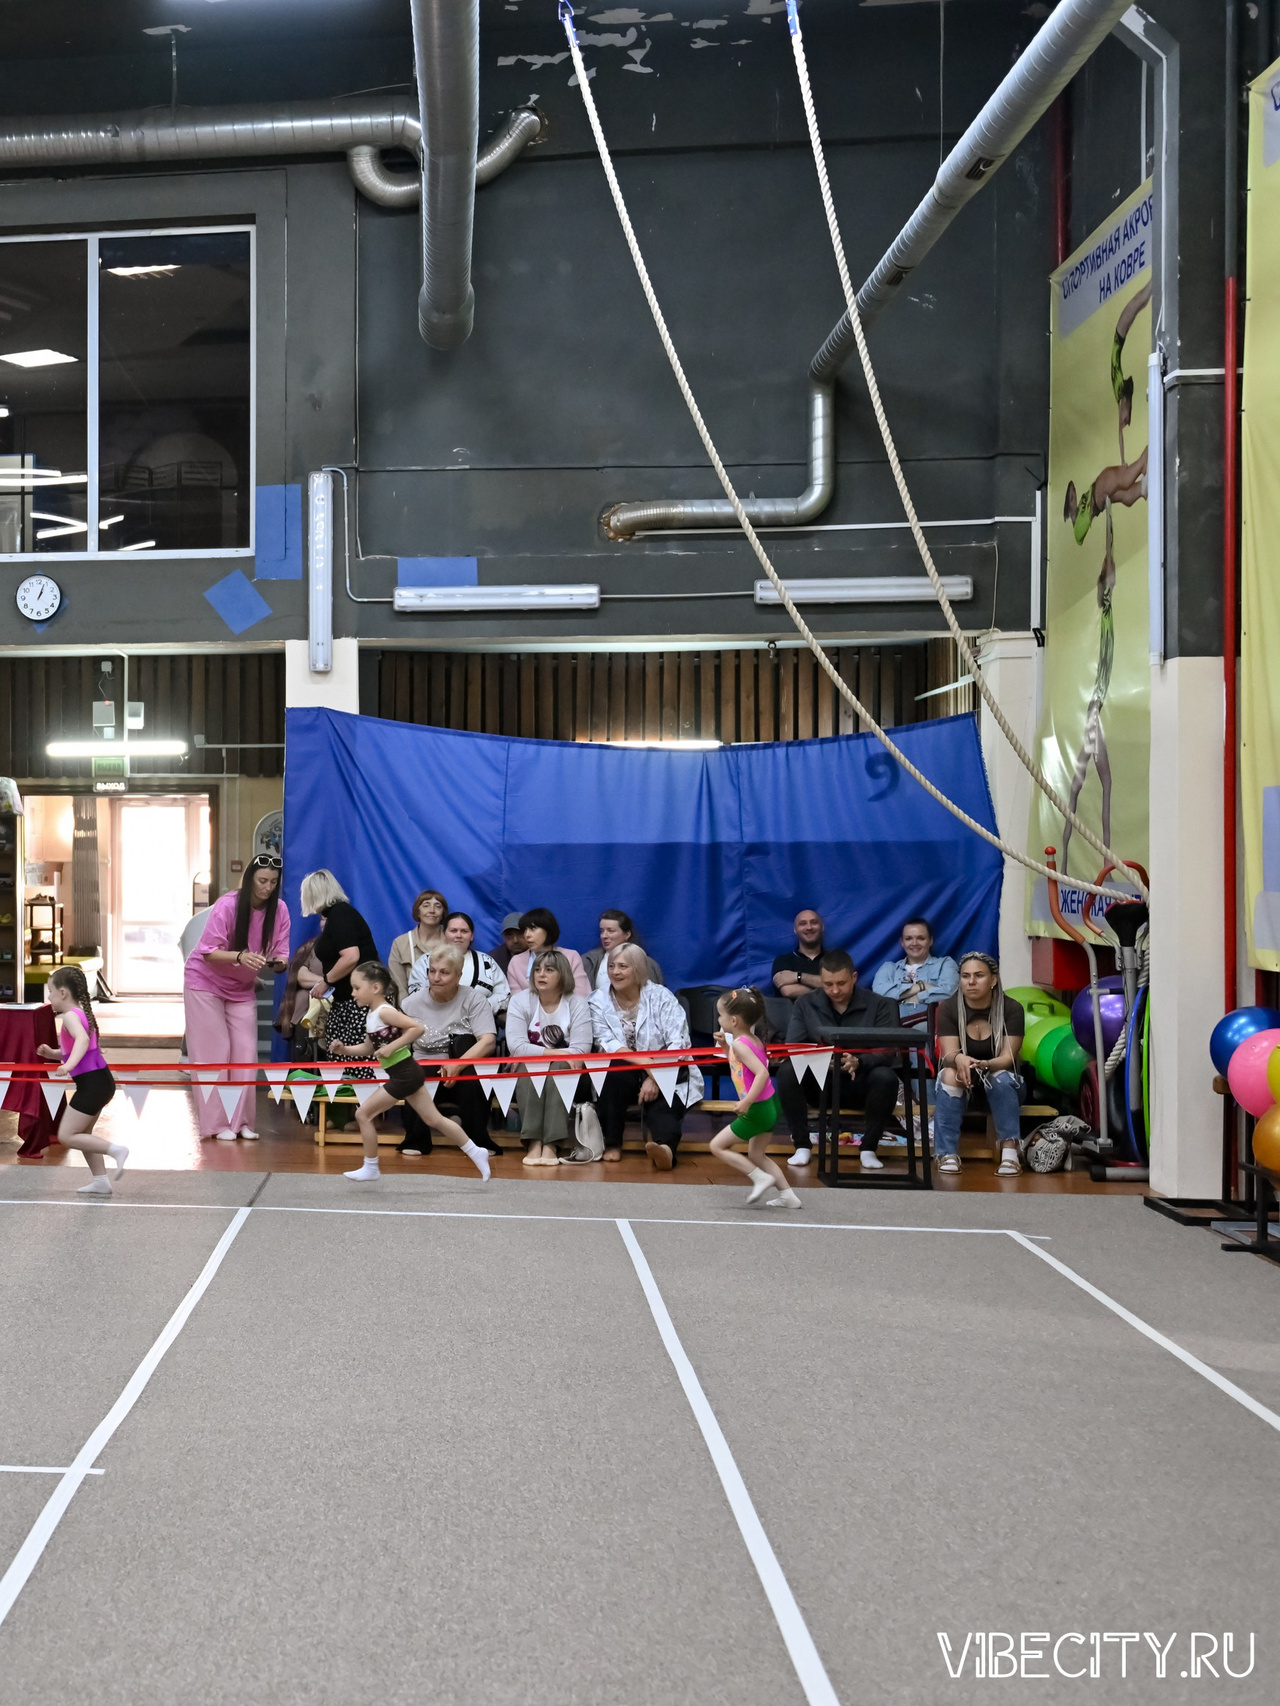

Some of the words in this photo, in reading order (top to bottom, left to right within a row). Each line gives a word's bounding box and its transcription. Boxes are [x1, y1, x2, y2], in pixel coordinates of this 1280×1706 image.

[1062, 226, 1120, 300] СПОРТИВНАЯ
[1099, 272, 1112, 304] НА
[1114, 241, 1146, 291] КОВРЕ
[96, 782, 126, 791] ВЫХОД
